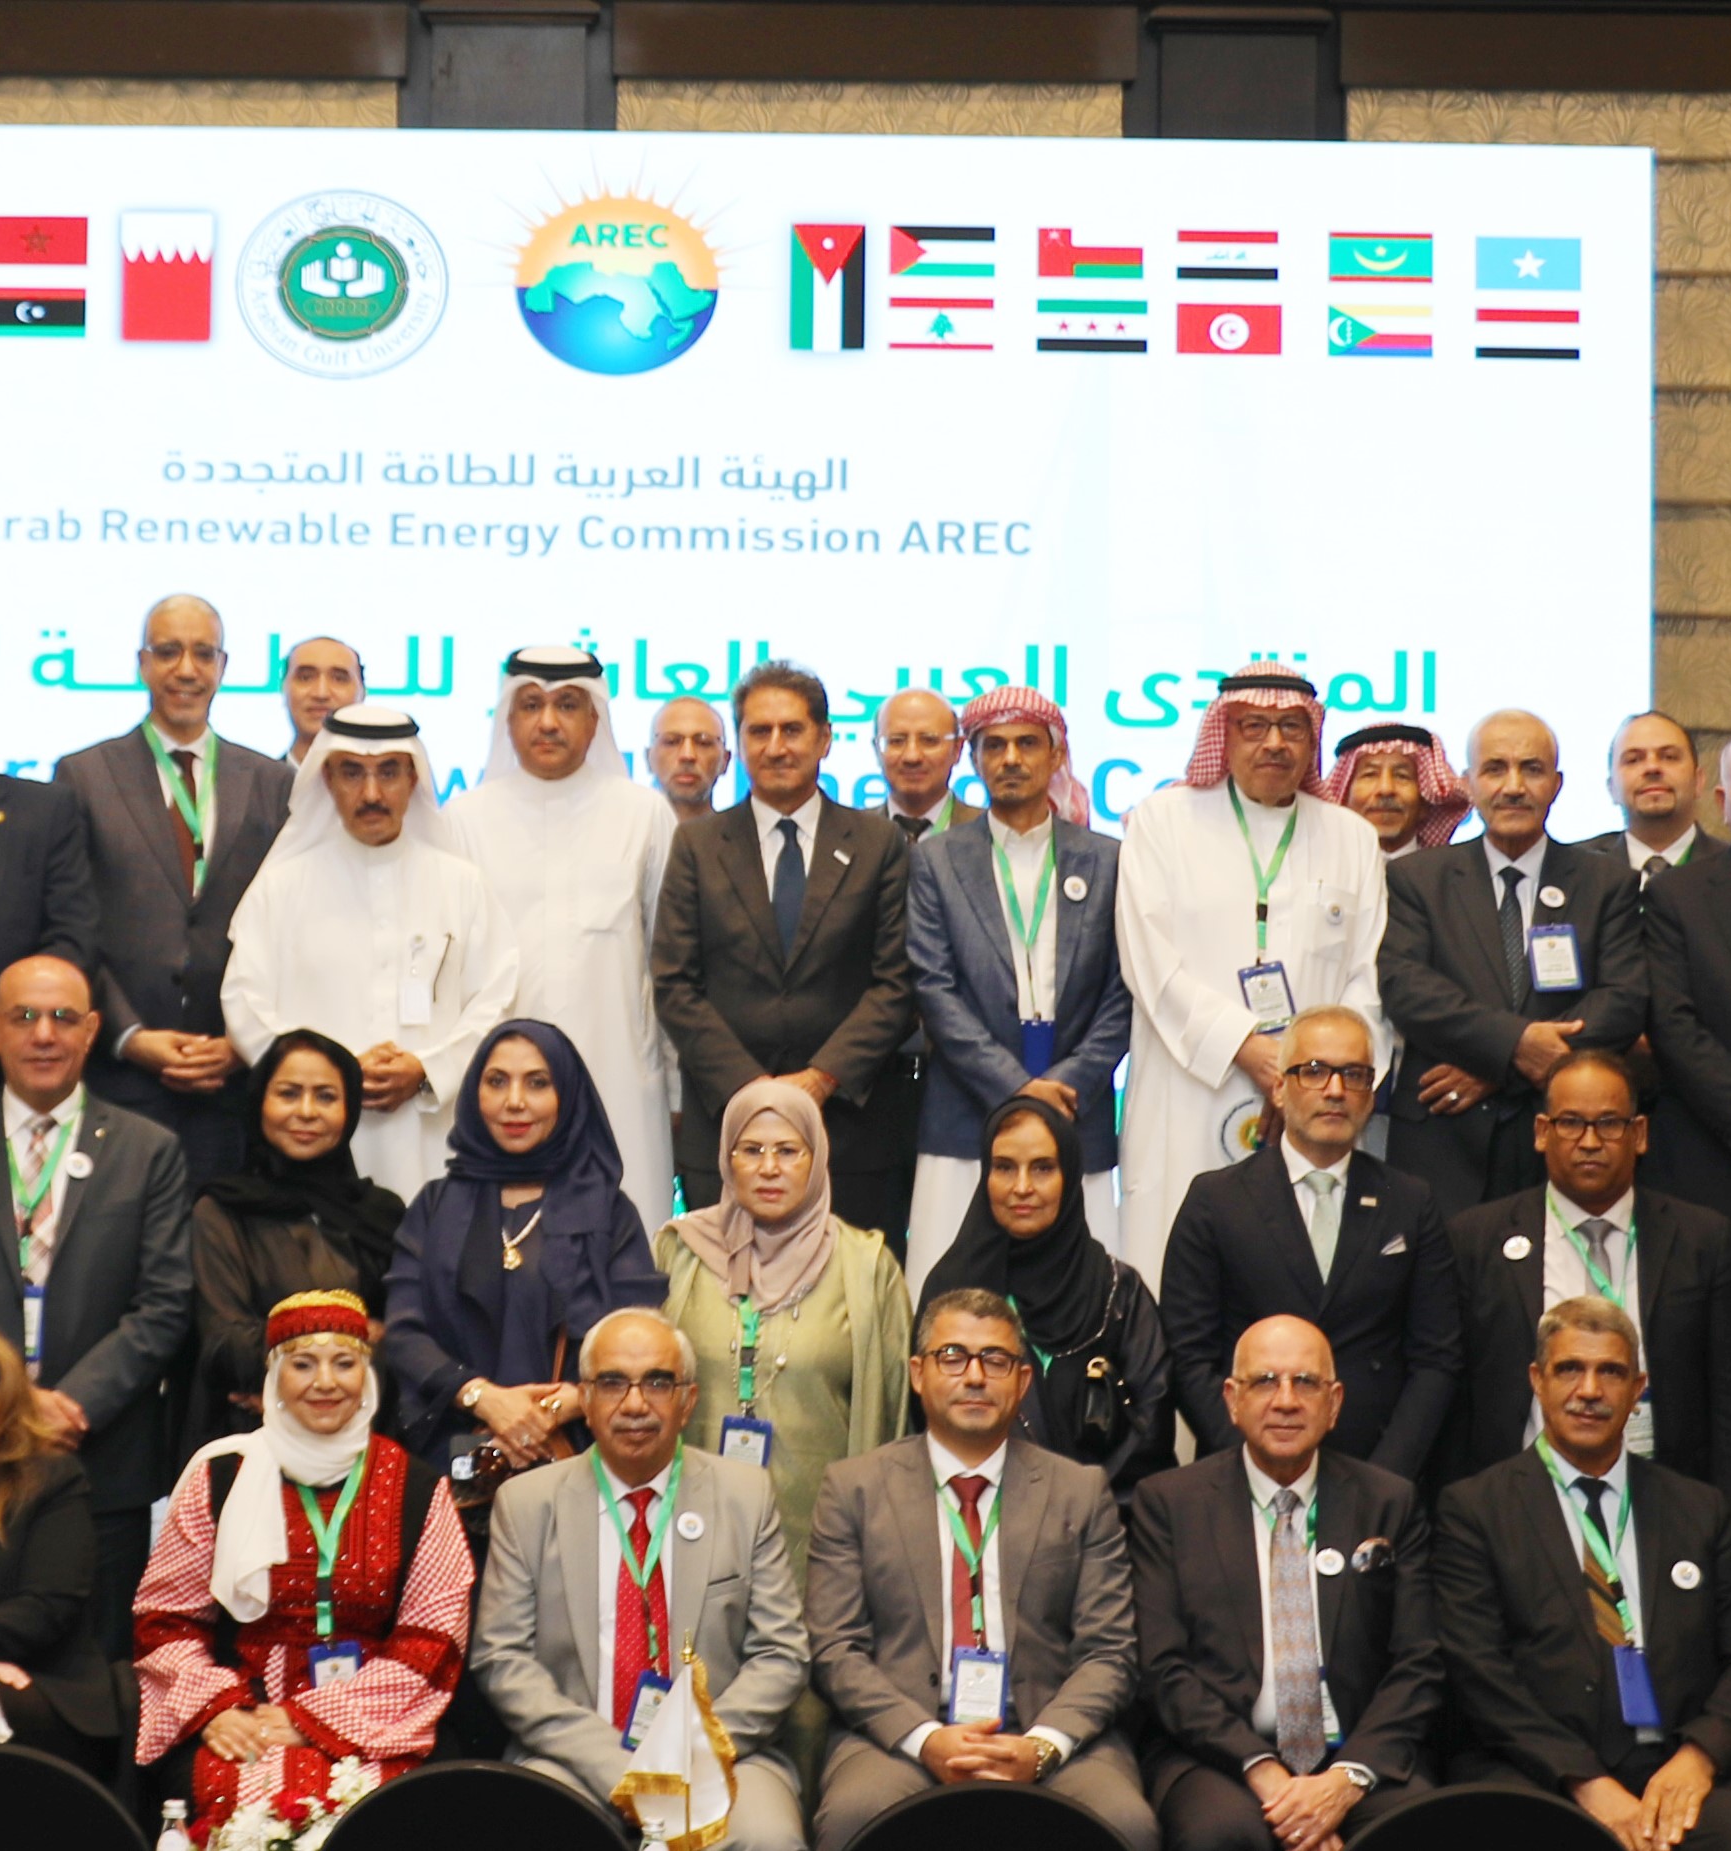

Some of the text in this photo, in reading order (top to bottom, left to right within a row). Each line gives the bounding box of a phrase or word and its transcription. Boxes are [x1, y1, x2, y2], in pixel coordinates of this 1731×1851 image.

[570, 223, 669, 248] AREC
[302, 343, 351, 367] Gulf
[355, 290, 437, 364] University
[162, 450, 848, 501] الهيئة العربية للطاقة المتجددة
[100, 508, 371, 547] Renewable
[389, 513, 560, 557] Energy
[578, 515, 881, 553] Commission
[898, 520, 1032, 556] AREC
